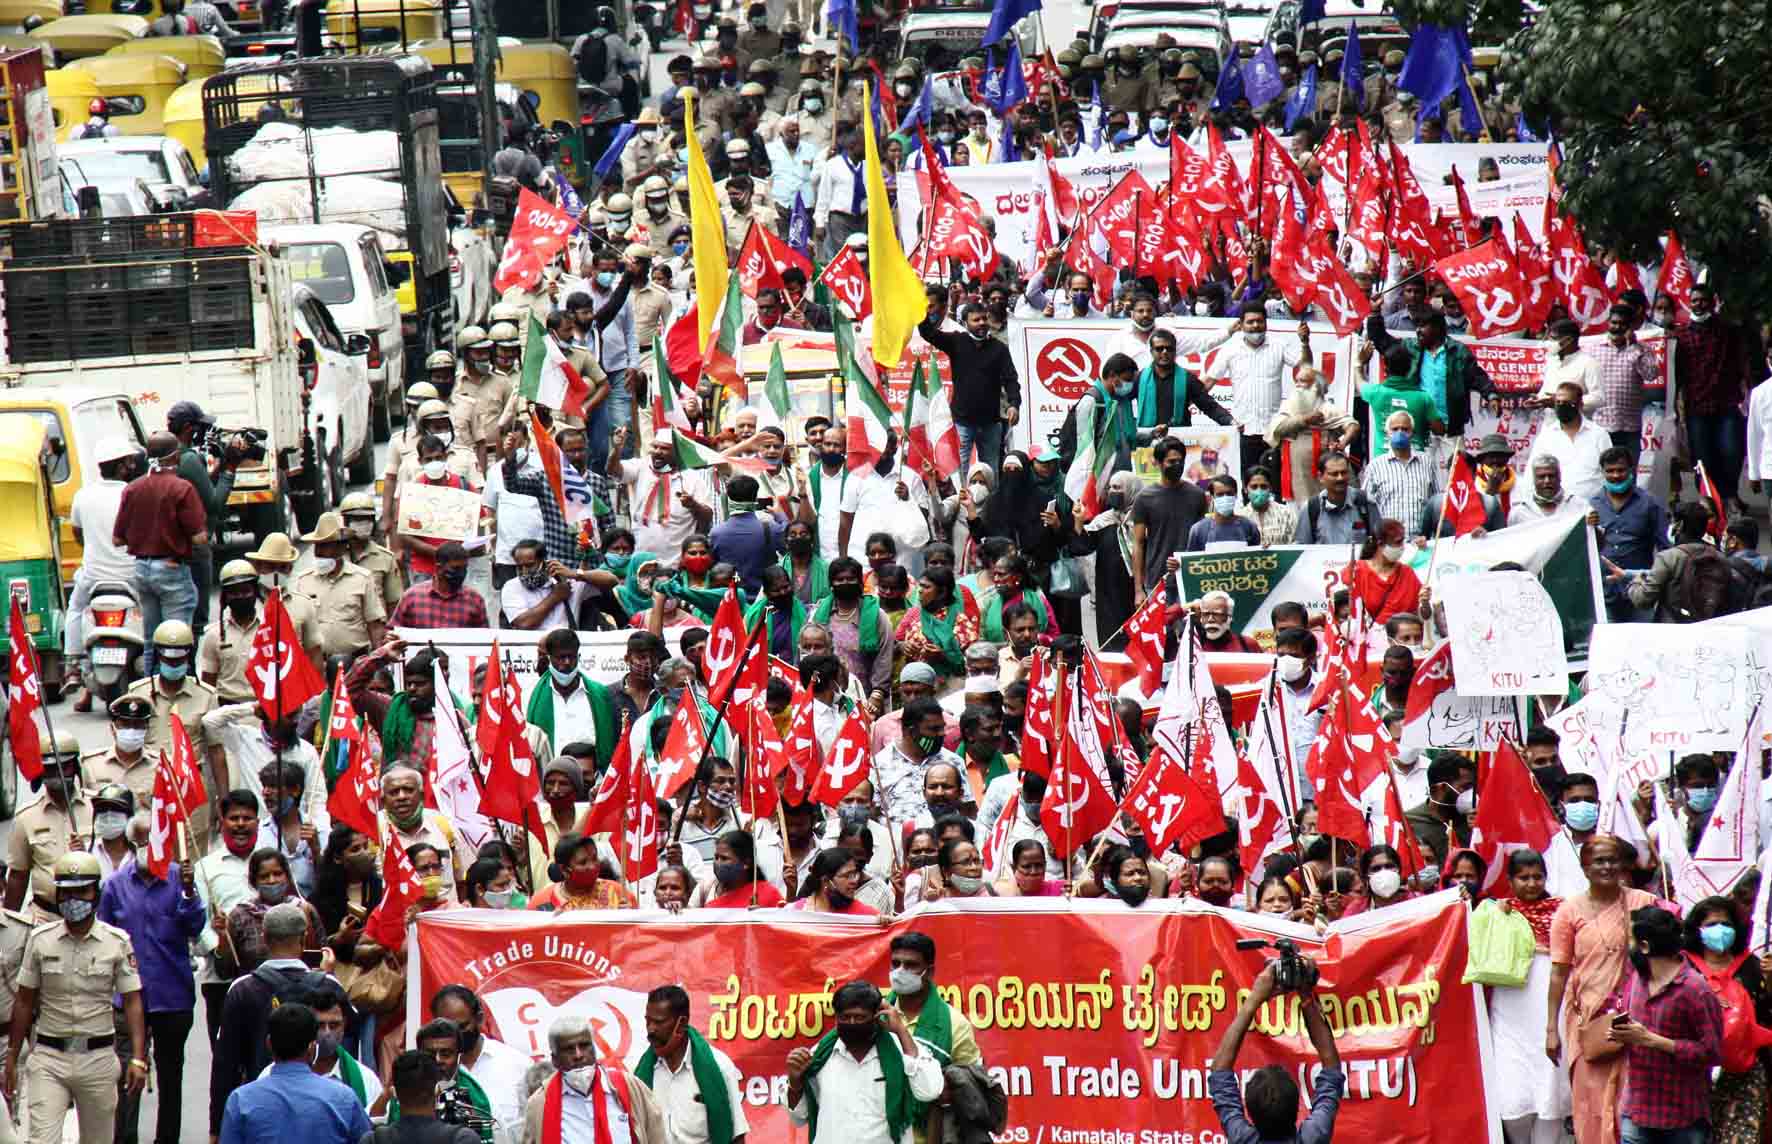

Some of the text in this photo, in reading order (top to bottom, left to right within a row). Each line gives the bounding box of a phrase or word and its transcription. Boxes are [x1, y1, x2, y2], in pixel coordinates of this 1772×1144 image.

[1040, 404, 1064, 412] ALL
[1187, 552, 1278, 575] ಕರ್ನಾಟಕ
[1491, 671, 1523, 688] KITU
[1650, 731, 1690, 744] KITU
[1625, 756, 1659, 786] ITU
[465, 935, 622, 981] Trade Unions
[1044, 1055, 1140, 1099] Trade
[1051, 1127, 1134, 1144] Karnataka
[1140, 1130, 1194, 1144] State
